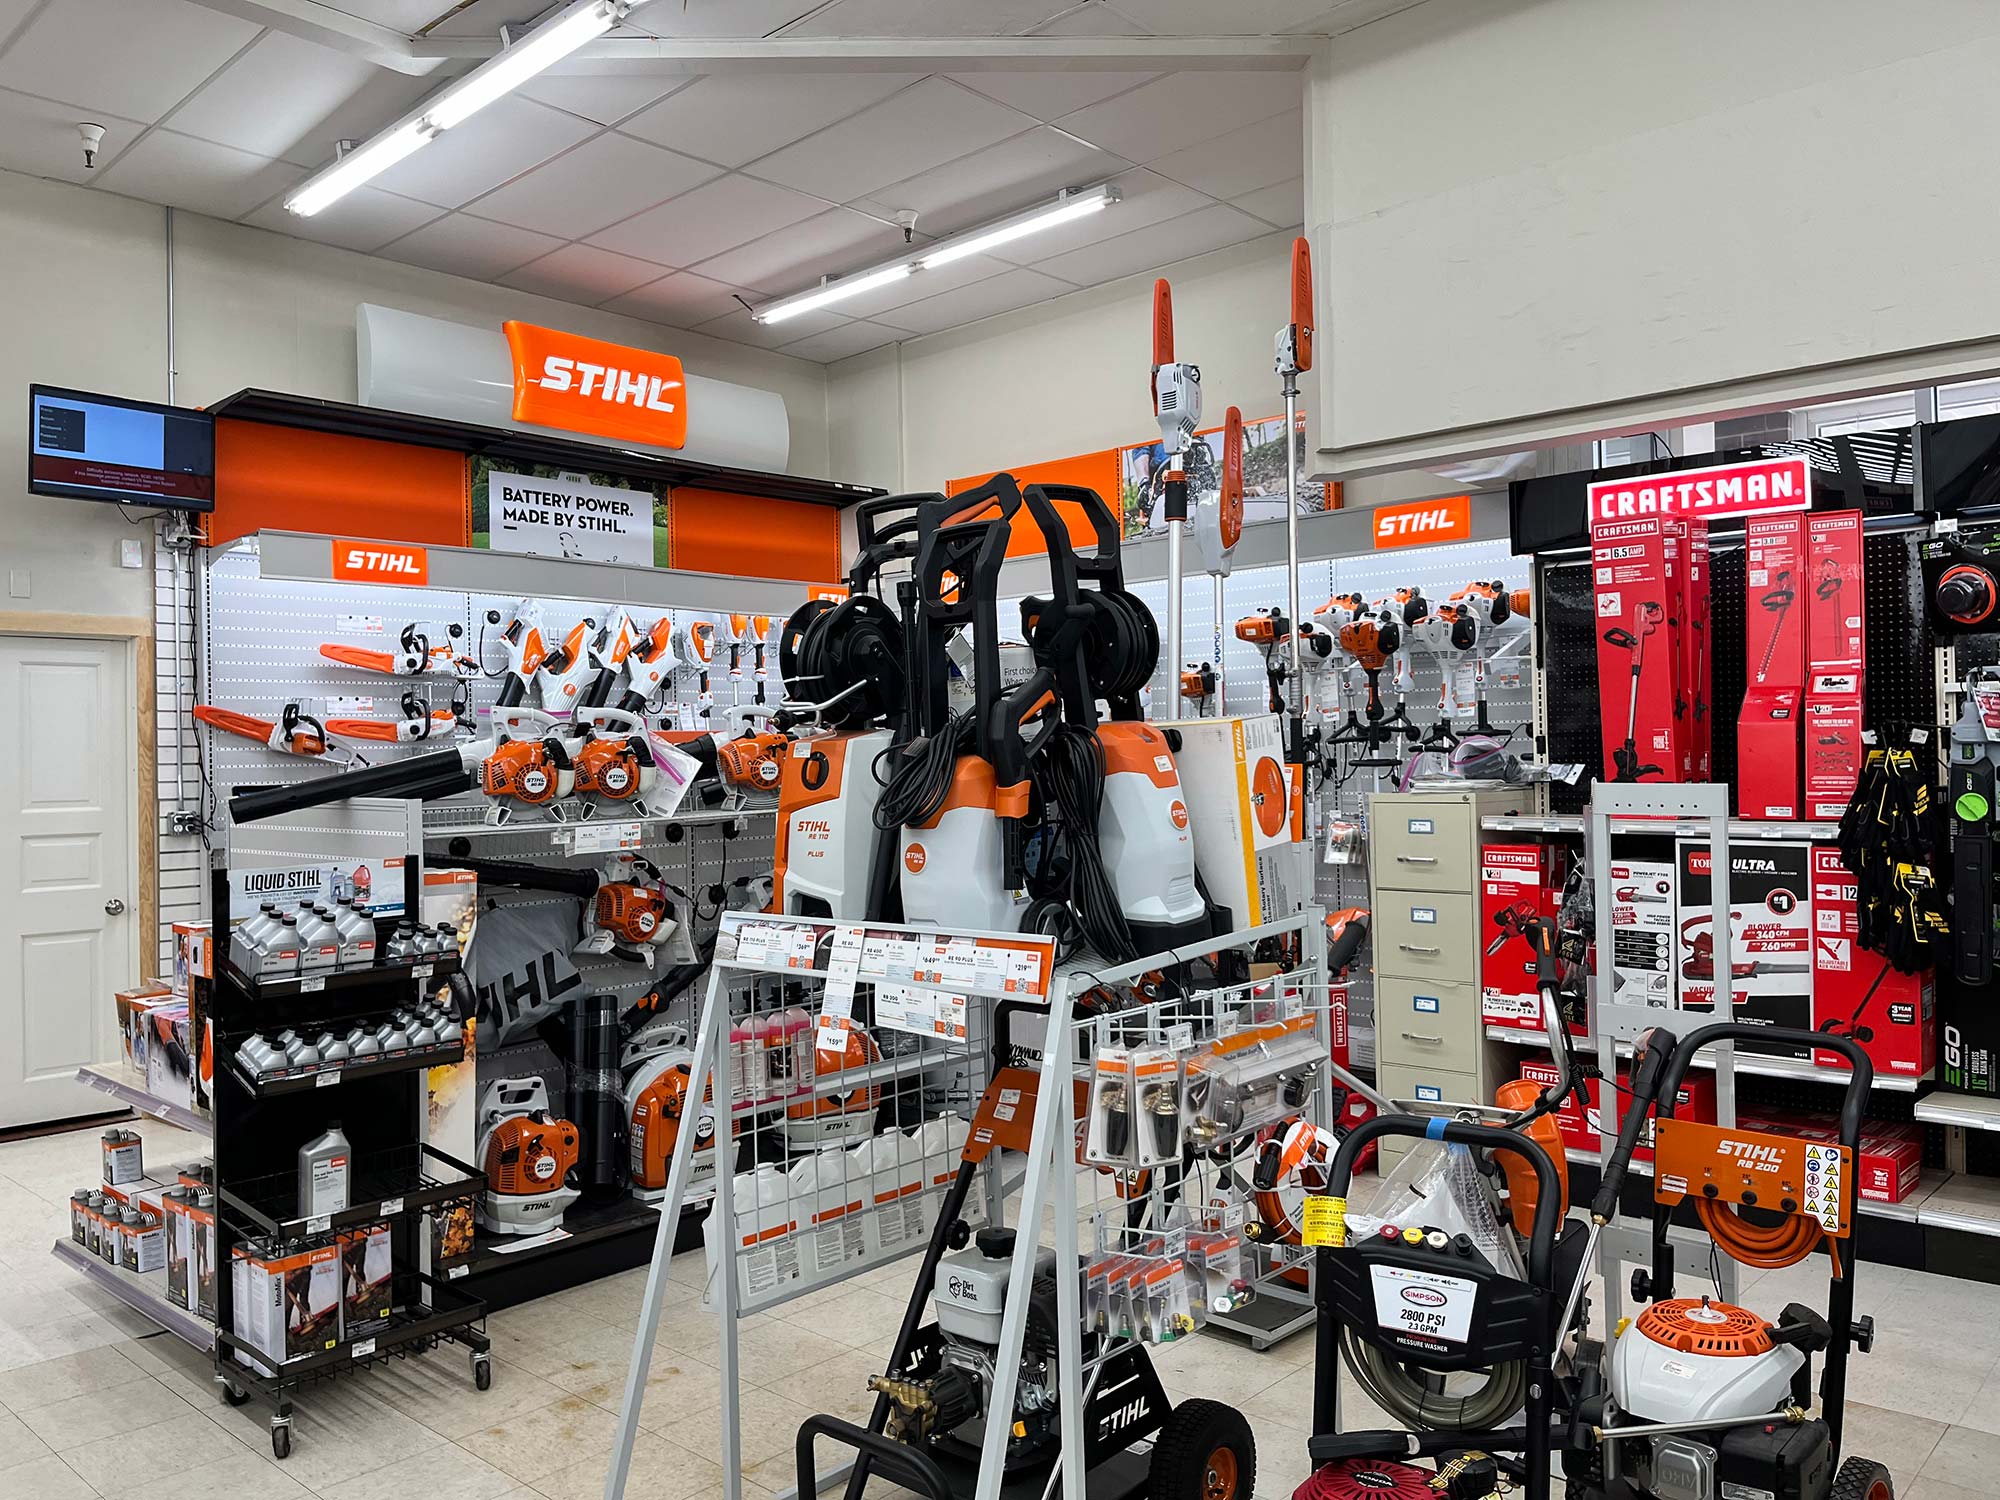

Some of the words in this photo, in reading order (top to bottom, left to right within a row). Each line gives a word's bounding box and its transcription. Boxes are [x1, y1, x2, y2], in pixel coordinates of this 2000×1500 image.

[540, 356, 675, 413] STIHL
[1600, 469, 1793, 518] CRAFTSMAN
[502, 487, 571, 509] BATTERY
[575, 496, 634, 517] POWER.
[502, 507, 549, 526] MADE
[553, 512, 575, 528] BY
[577, 517, 627, 534] STIHL.
[1377, 508, 1456, 536] STIHL
[1813, 520, 1854, 530] CRAFTSMAN
[1597, 523, 1654, 537] CRAFTSMAN
[1752, 523, 1795, 532] CRAFTSMAN
[1613, 547, 1628, 558] 6.5
[1628, 546, 1643, 556] AMP
[346, 551, 421, 573] STIHL
[1004, 667, 1018, 676] First
[1019, 666, 1038, 676] choic
[1235, 726, 1243, 760] STIHL
[797, 820, 830, 832] STIHL
[906, 852, 924, 860] STIHL
[1487, 854, 1534, 864] CRAFTSMAN
[1732, 858, 1776, 871] ULTRA
[244, 872, 285, 892] LIQUID
[288, 869, 322, 888] STIHL
[1486, 869, 1501, 879] V20
[1756, 930, 1775, 939] 340
[1760, 942, 1780, 951] 260
[1891, 1005, 1898, 1013] 3
[1335, 996, 1344, 1043] CAFTSMAN
[1944, 1025, 1960, 1088] EGO
[1526, 1071, 1559, 1082] CRAFTS
[1299, 1128, 1312, 1147] STIHL
[1716, 1140, 1783, 1164] STIHL
[694, 1163, 715, 1173] TIHL
[1737, 1160, 1754, 1169] RB
[1755, 1163, 1780, 1173] 200
[522, 1201, 551, 1211] STIHL
[312, 1252, 333, 1262] STIHL
[962, 1279, 974, 1292] Dirt
[1405, 1290, 1443, 1303] SIMPSON
[1400, 1309, 1425, 1323] 2800
[1426, 1313, 1446, 1327] PSI
[1408, 1322, 1419, 1331] 2.3
[1420, 1324, 1438, 1334] GPM
[1396, 1336, 1424, 1348] PRESSURE
[1424, 1341, 1448, 1352] WASHER
[1356, 1474, 1393, 1487] HONDA
